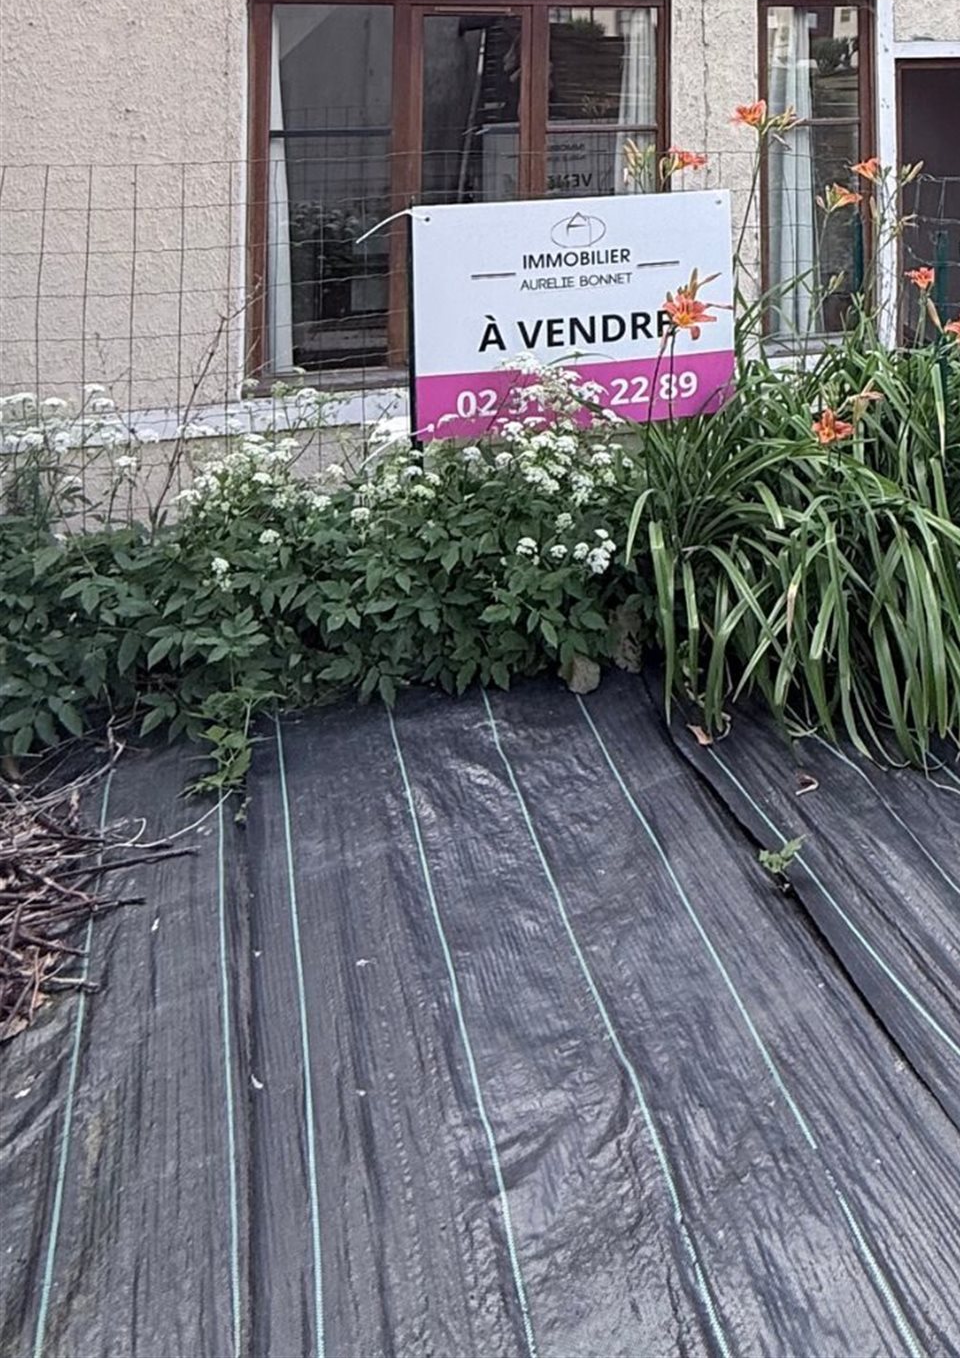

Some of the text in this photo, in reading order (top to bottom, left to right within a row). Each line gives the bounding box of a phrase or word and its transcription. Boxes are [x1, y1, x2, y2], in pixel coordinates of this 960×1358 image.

[522, 248, 631, 270] IMMOBILIER
[520, 272, 632, 291] AURELIE BONNET
[478, 314, 507, 353] À
[456, 389, 498, 418] 02
[610, 376, 650, 405] 22
[659, 371, 698, 399] 89
